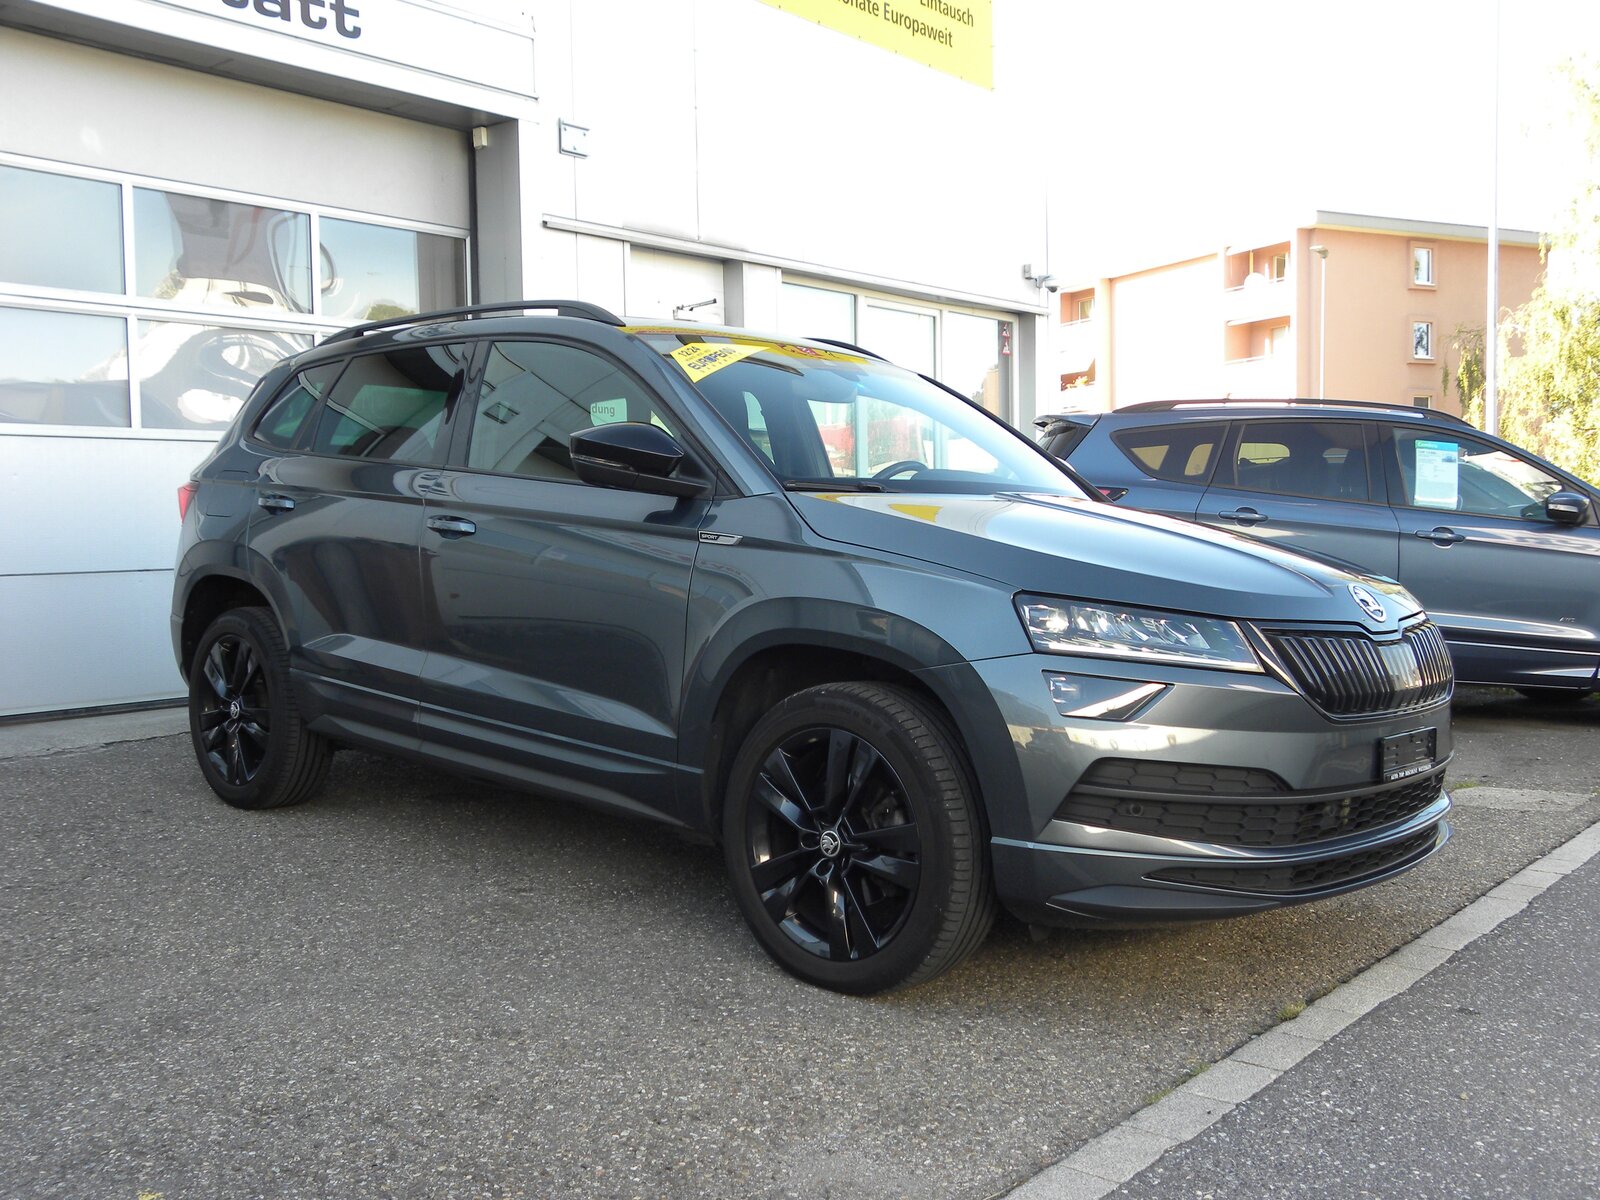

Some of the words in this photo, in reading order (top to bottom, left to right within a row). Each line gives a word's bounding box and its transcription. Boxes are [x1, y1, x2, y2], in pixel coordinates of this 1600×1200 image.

[221, 0, 362, 39] att
[840, 0, 880, 17] nate
[883, 2, 953, 48] Europaweit
[591, 404, 616, 417] dung
